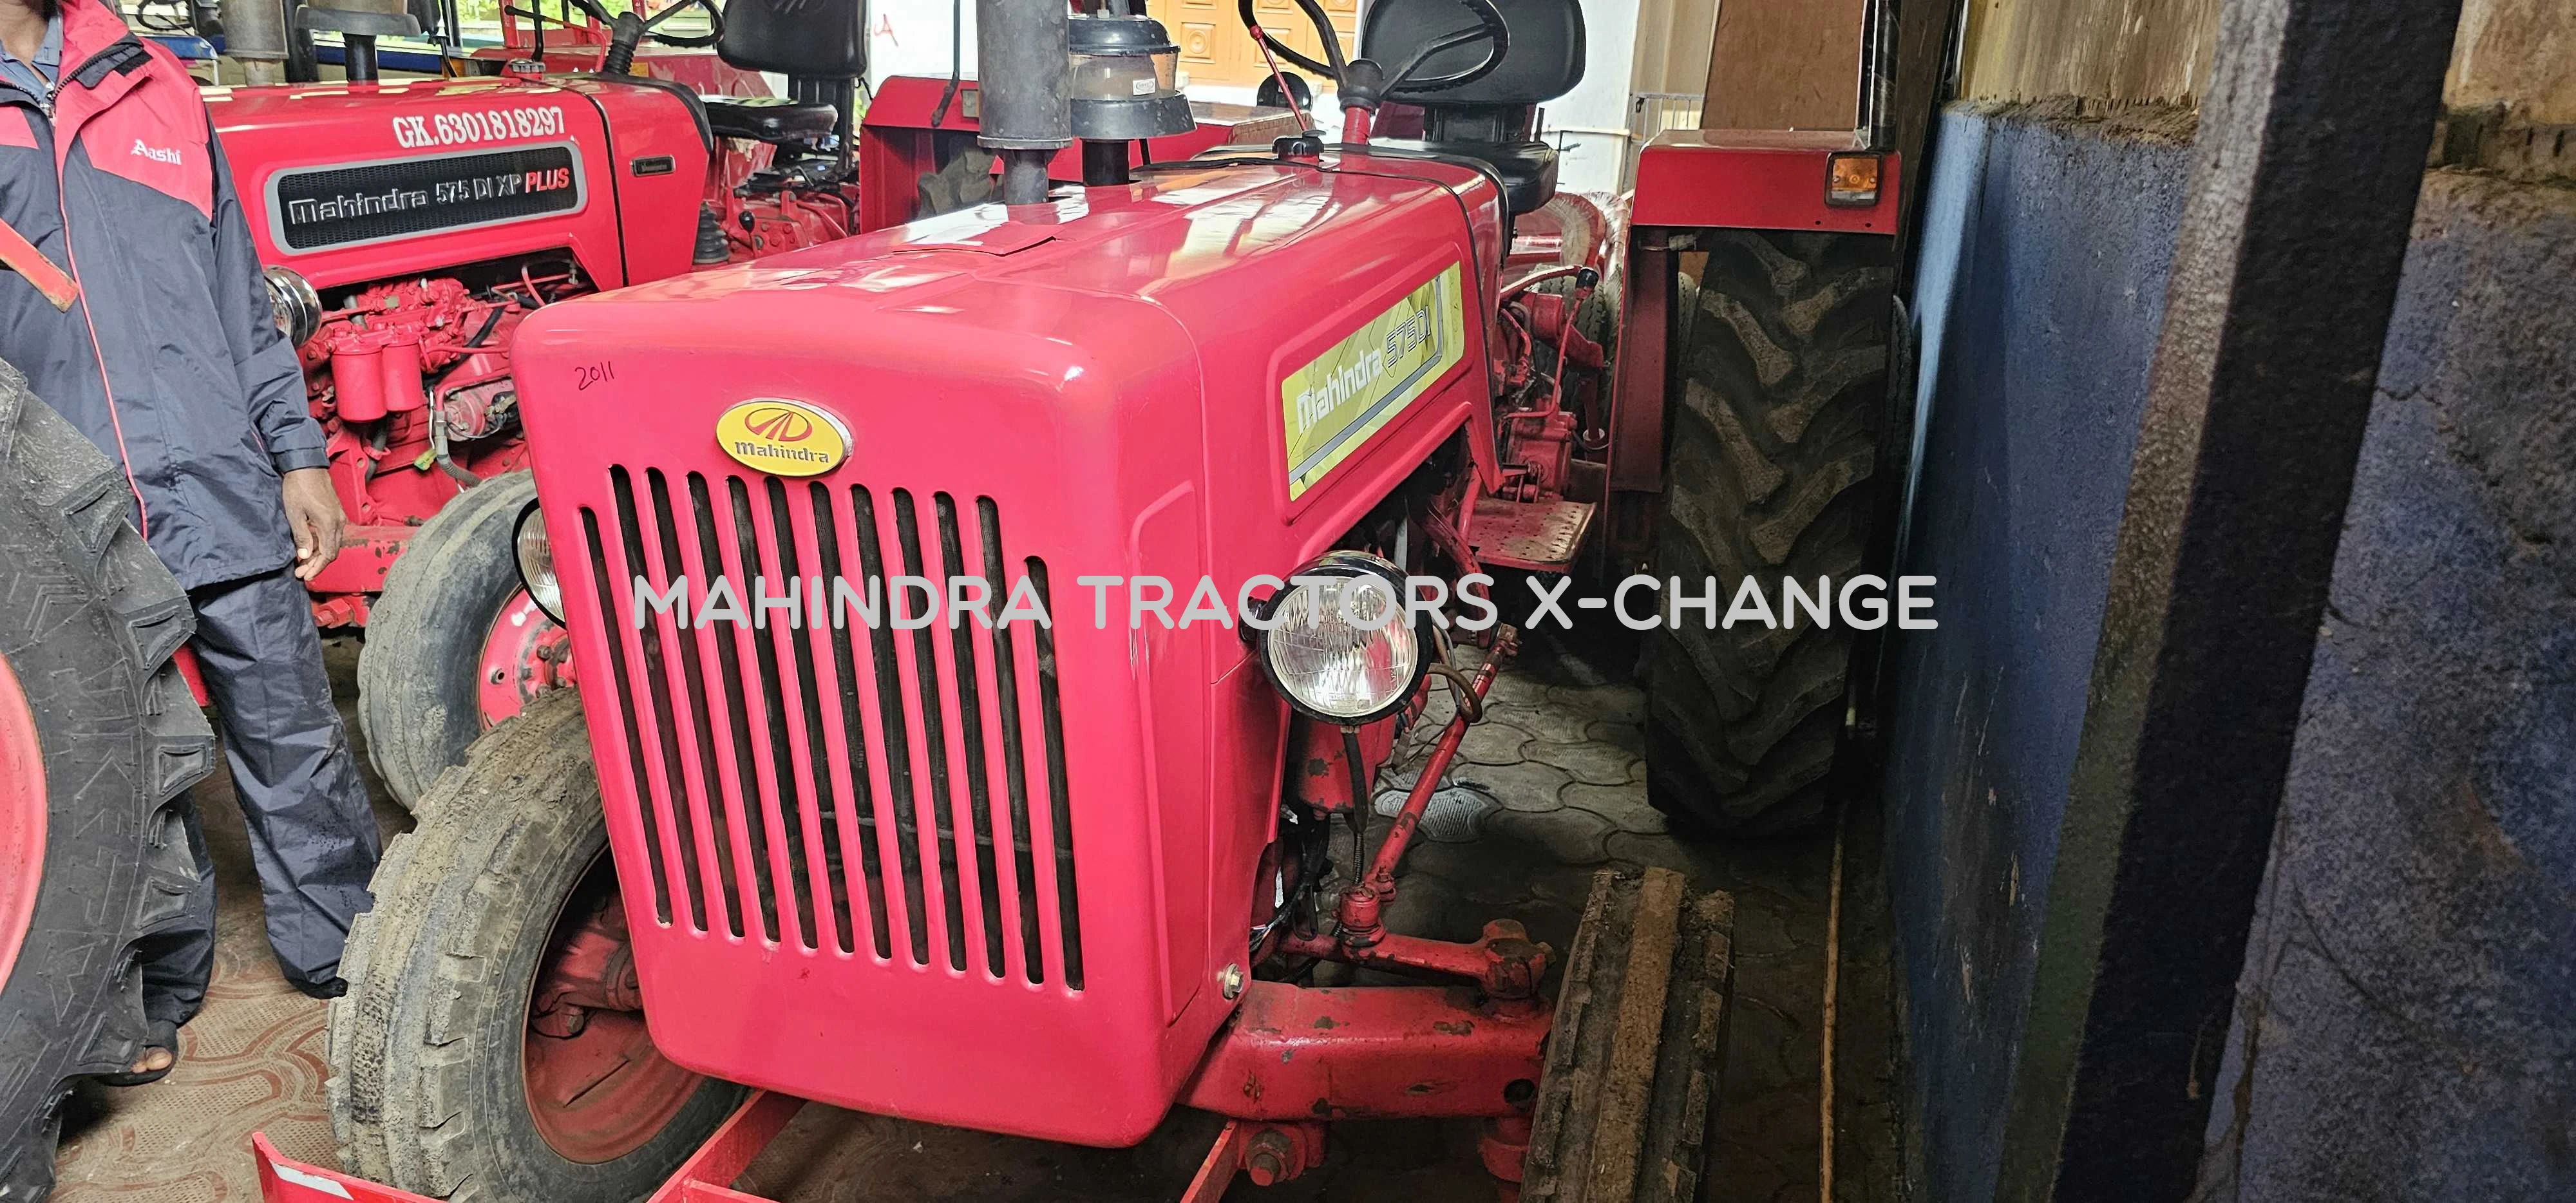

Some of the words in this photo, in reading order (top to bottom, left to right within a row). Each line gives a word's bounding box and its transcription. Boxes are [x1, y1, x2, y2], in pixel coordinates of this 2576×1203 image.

[392, 106, 565, 149] GK.6301818297
[131, 138, 182, 166] Aashi
[289, 188, 429, 225] Mahindra
[435, 180, 470, 205] 575
[473, 176, 493, 200] DI
[495, 173, 522, 197] XP
[525, 167, 569, 194] PLUS
[574, 360, 614, 391] 2011
[1296, 348, 1382, 434] Mahindra
[735, 440, 830, 464] Mahindra
